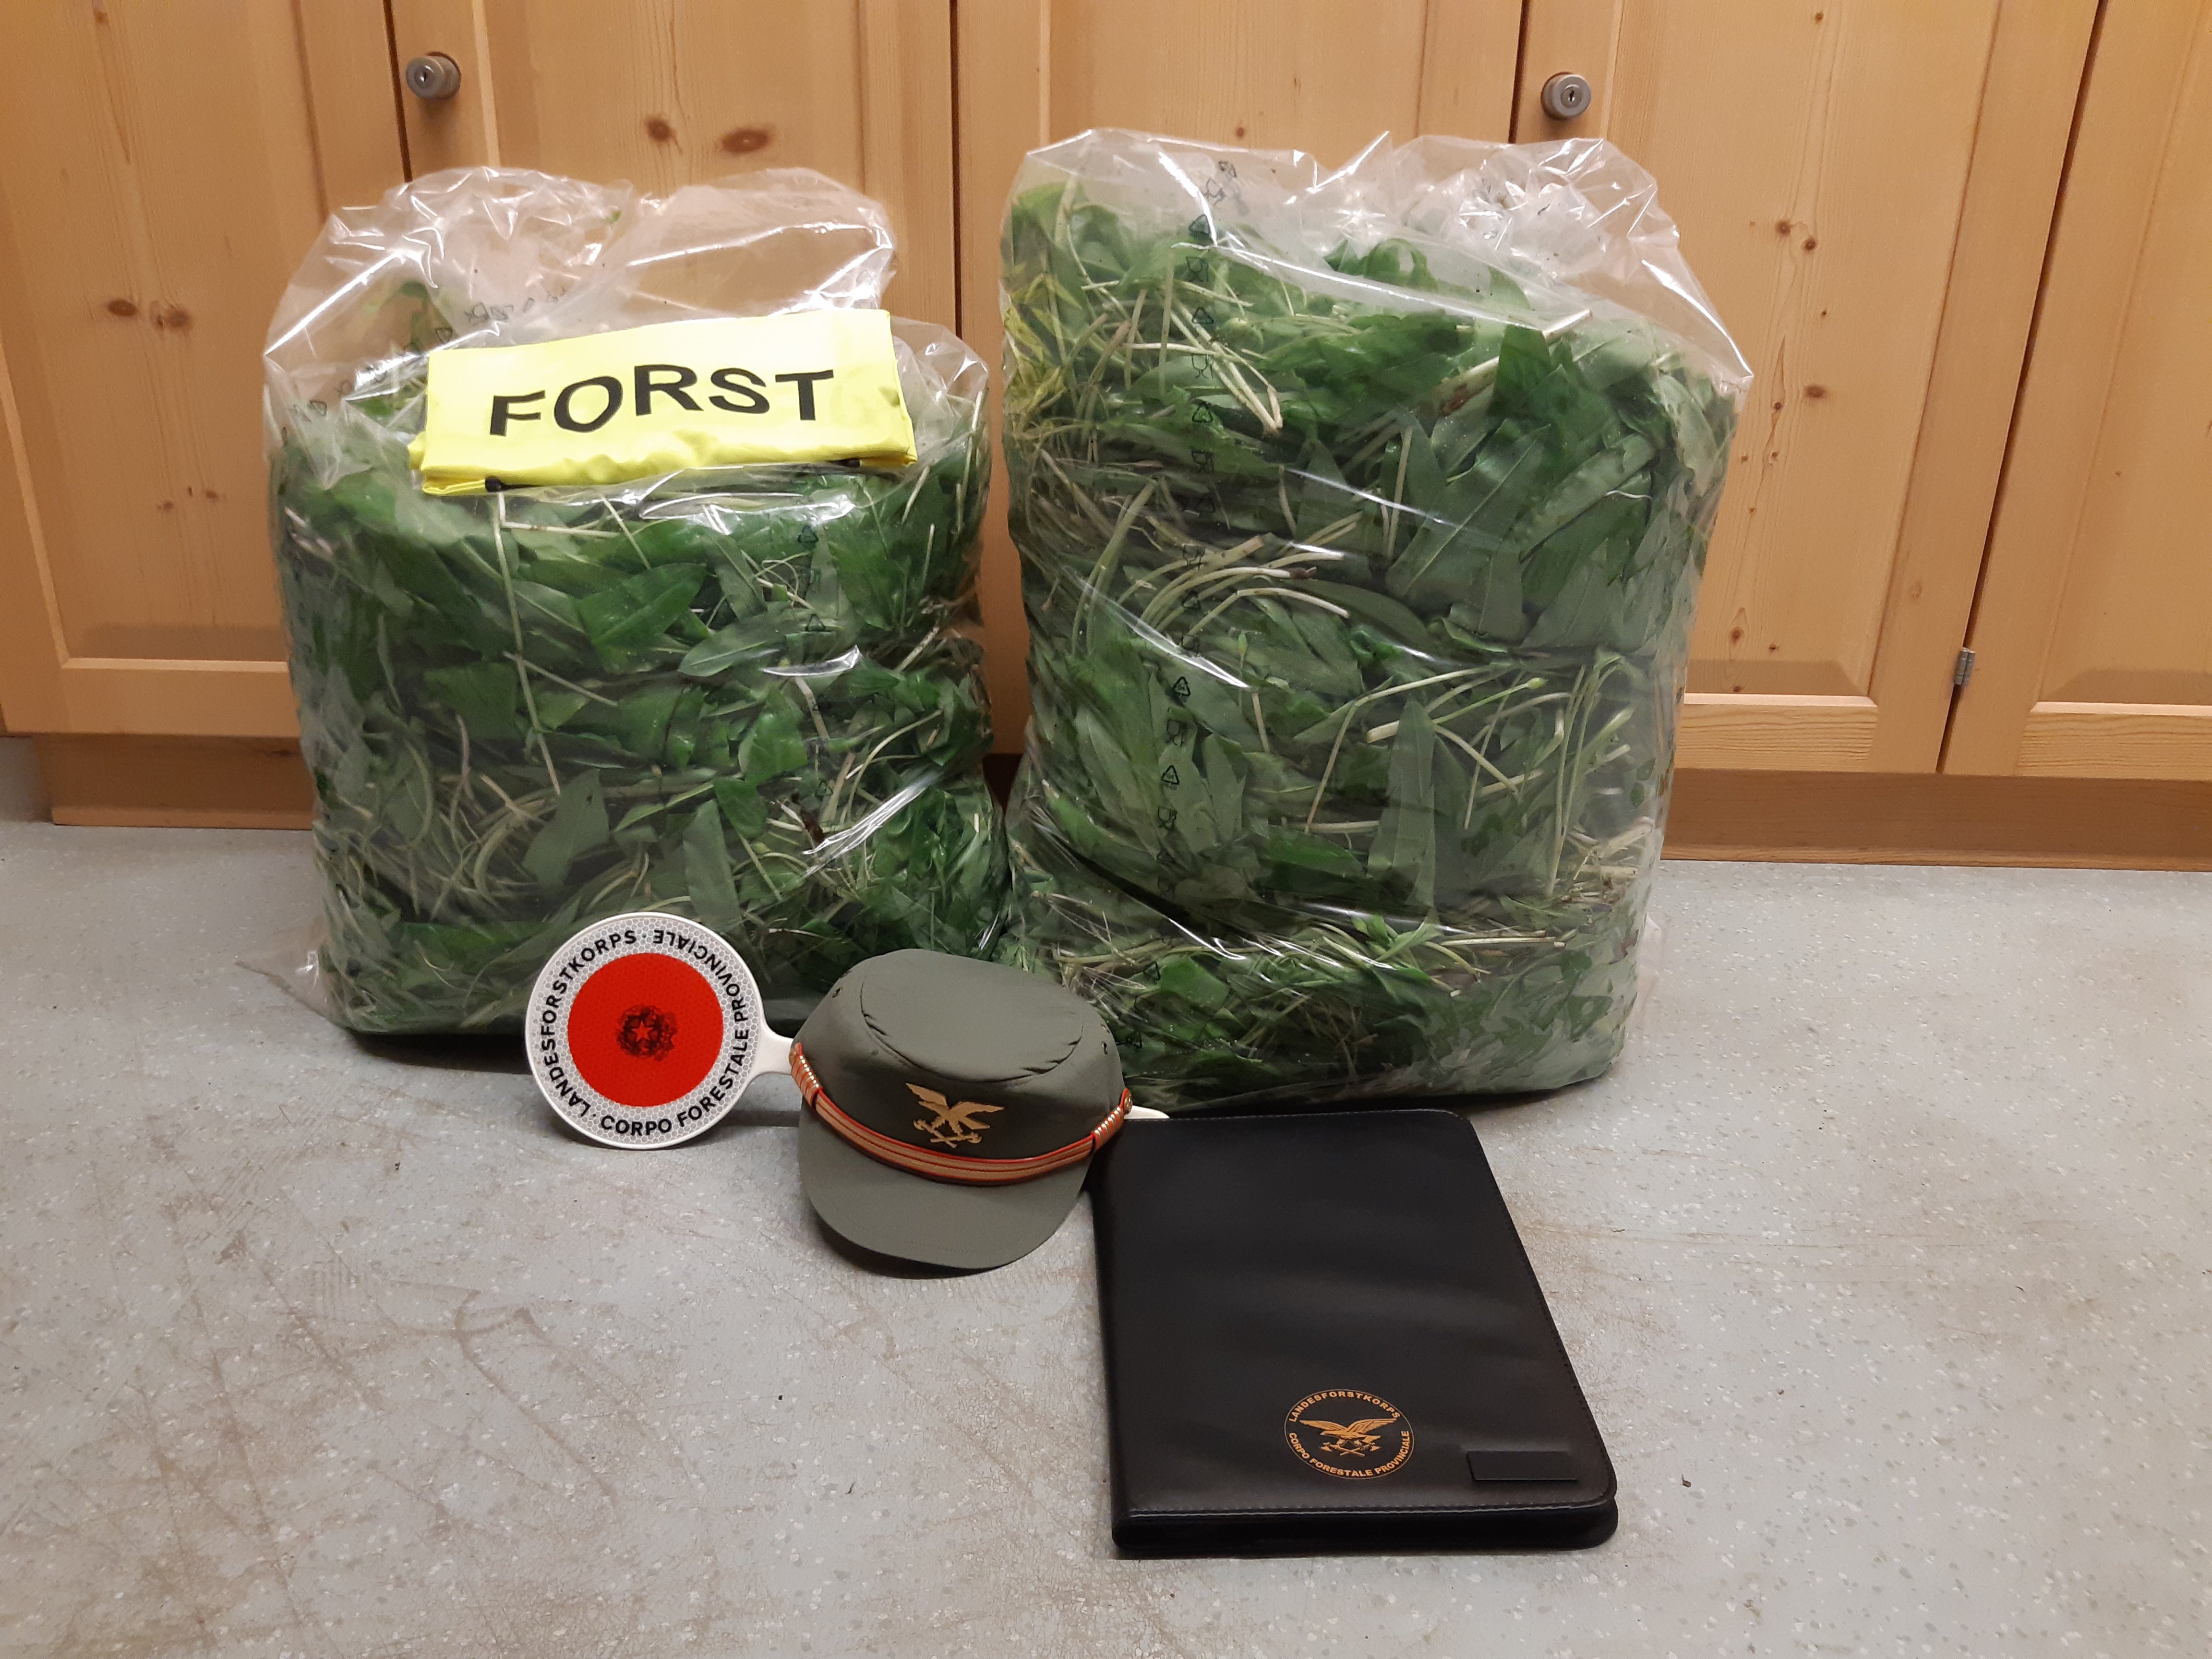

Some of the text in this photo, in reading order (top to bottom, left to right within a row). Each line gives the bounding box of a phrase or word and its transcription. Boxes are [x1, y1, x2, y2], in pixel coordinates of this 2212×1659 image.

[489, 364, 834, 437] FORST
[541, 930, 637, 1117] LANDESFORSTKORPS
[601, 929, 749, 1136] CORPO FORESTALE PROVINCIALE
[1289, 1391, 1400, 1422] LANDESFORSTKORPS
[1289, 1430, 1410, 1477] CORPO FORESTALE PROVINCIALE
